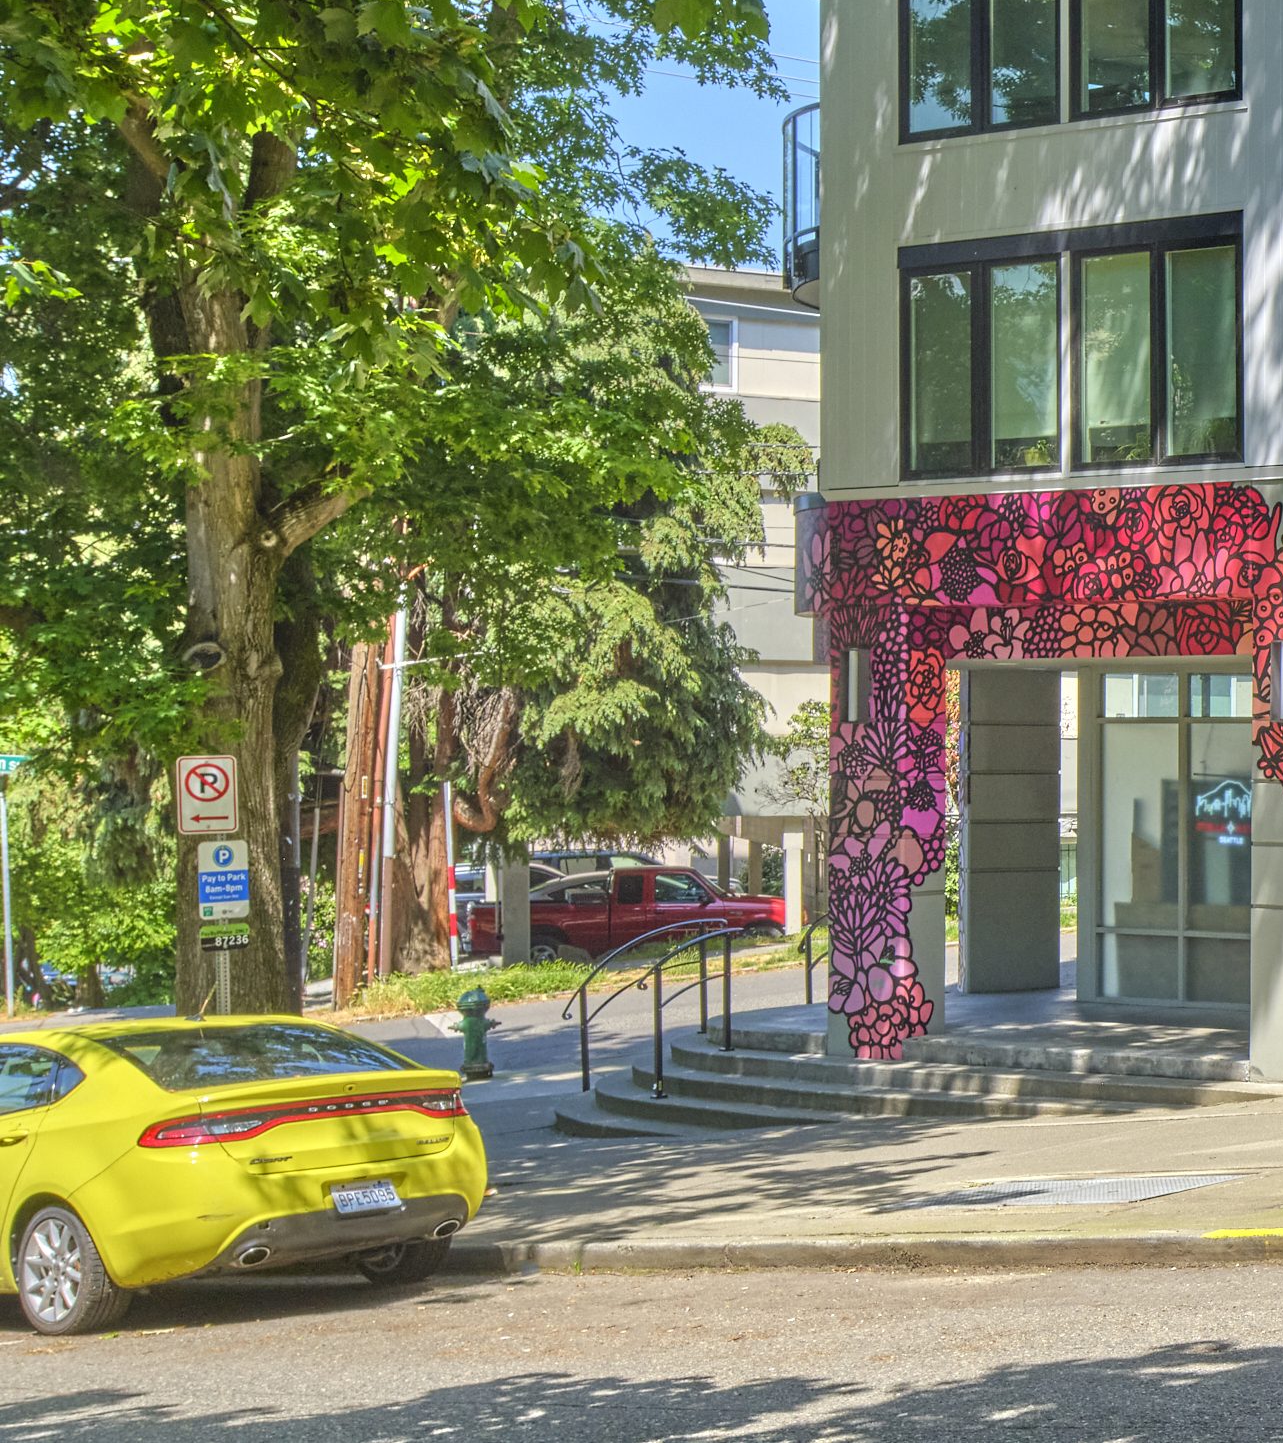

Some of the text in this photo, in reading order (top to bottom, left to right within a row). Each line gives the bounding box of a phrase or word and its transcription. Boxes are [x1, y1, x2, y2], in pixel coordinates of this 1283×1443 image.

[201, 872, 247, 884] Pay to Park
[215, 934, 250, 947] 87236
